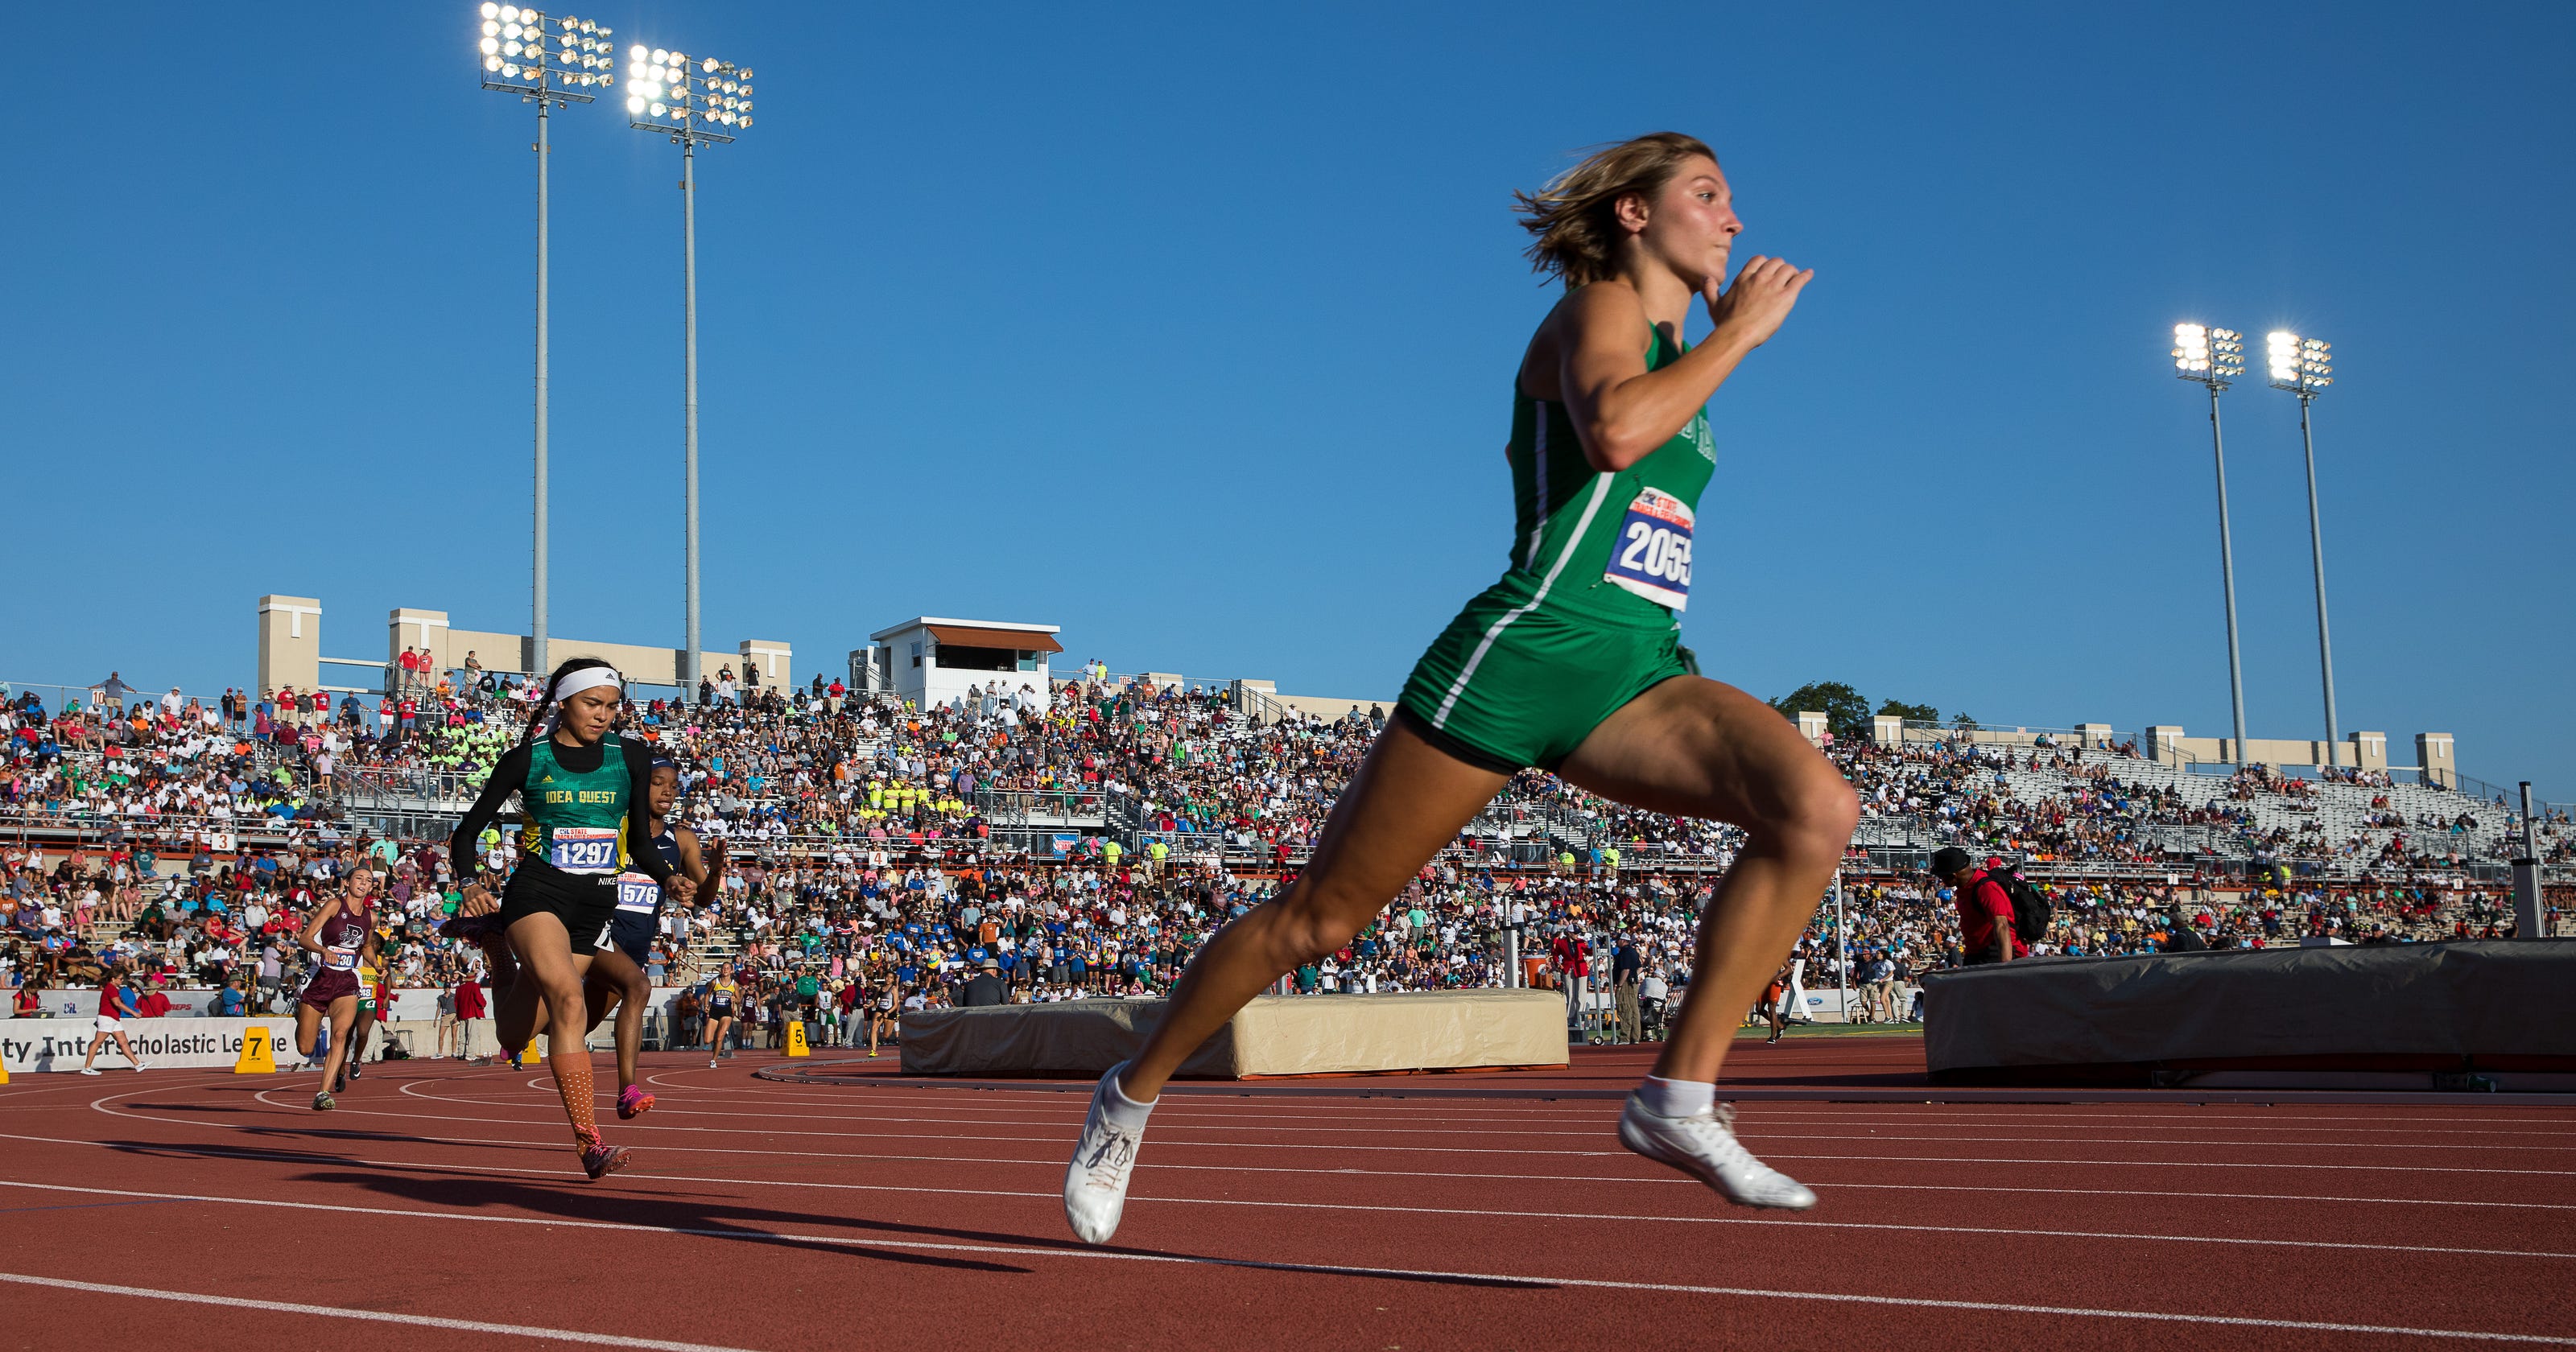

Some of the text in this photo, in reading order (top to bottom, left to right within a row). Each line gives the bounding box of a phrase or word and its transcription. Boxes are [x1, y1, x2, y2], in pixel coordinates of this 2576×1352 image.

[1620, 521, 1691, 587] 2055
[546, 790, 617, 804] IDEA QUEST
[219, 835, 228, 849] 3
[558, 842, 614, 865] 1297
[874, 852, 882, 865] 4
[598, 877, 616, 885] NIKE
[337, 954, 353, 967] 30
[222, 1034, 287, 1053] Lee
[795, 1029, 803, 1045] 5
[249, 1037, 262, 1057] 7
